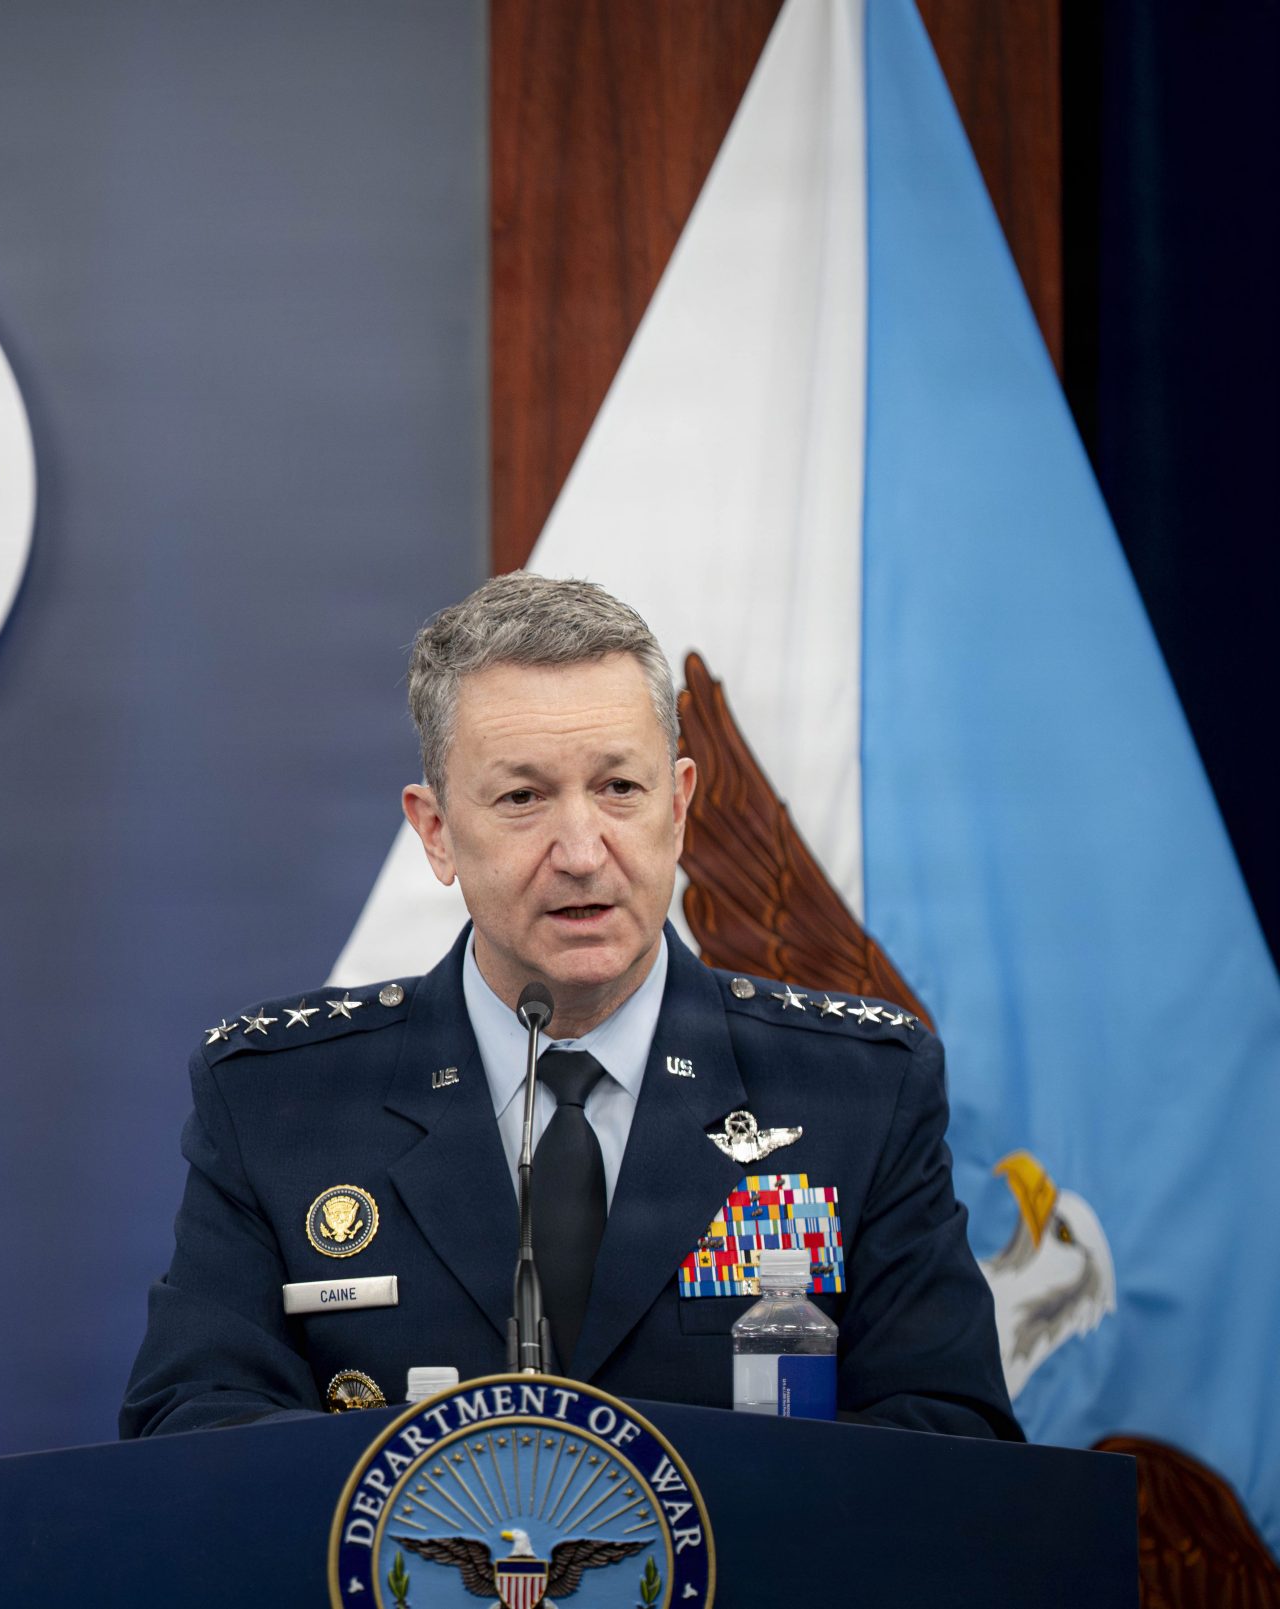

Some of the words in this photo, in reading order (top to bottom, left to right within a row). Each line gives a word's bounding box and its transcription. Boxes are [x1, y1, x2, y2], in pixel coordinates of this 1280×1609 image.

[320, 1287, 357, 1303] CAINE
[344, 1384, 579, 1549] DEPARTMENT
[587, 1406, 642, 1448] OF
[648, 1454, 702, 1555] WAR
